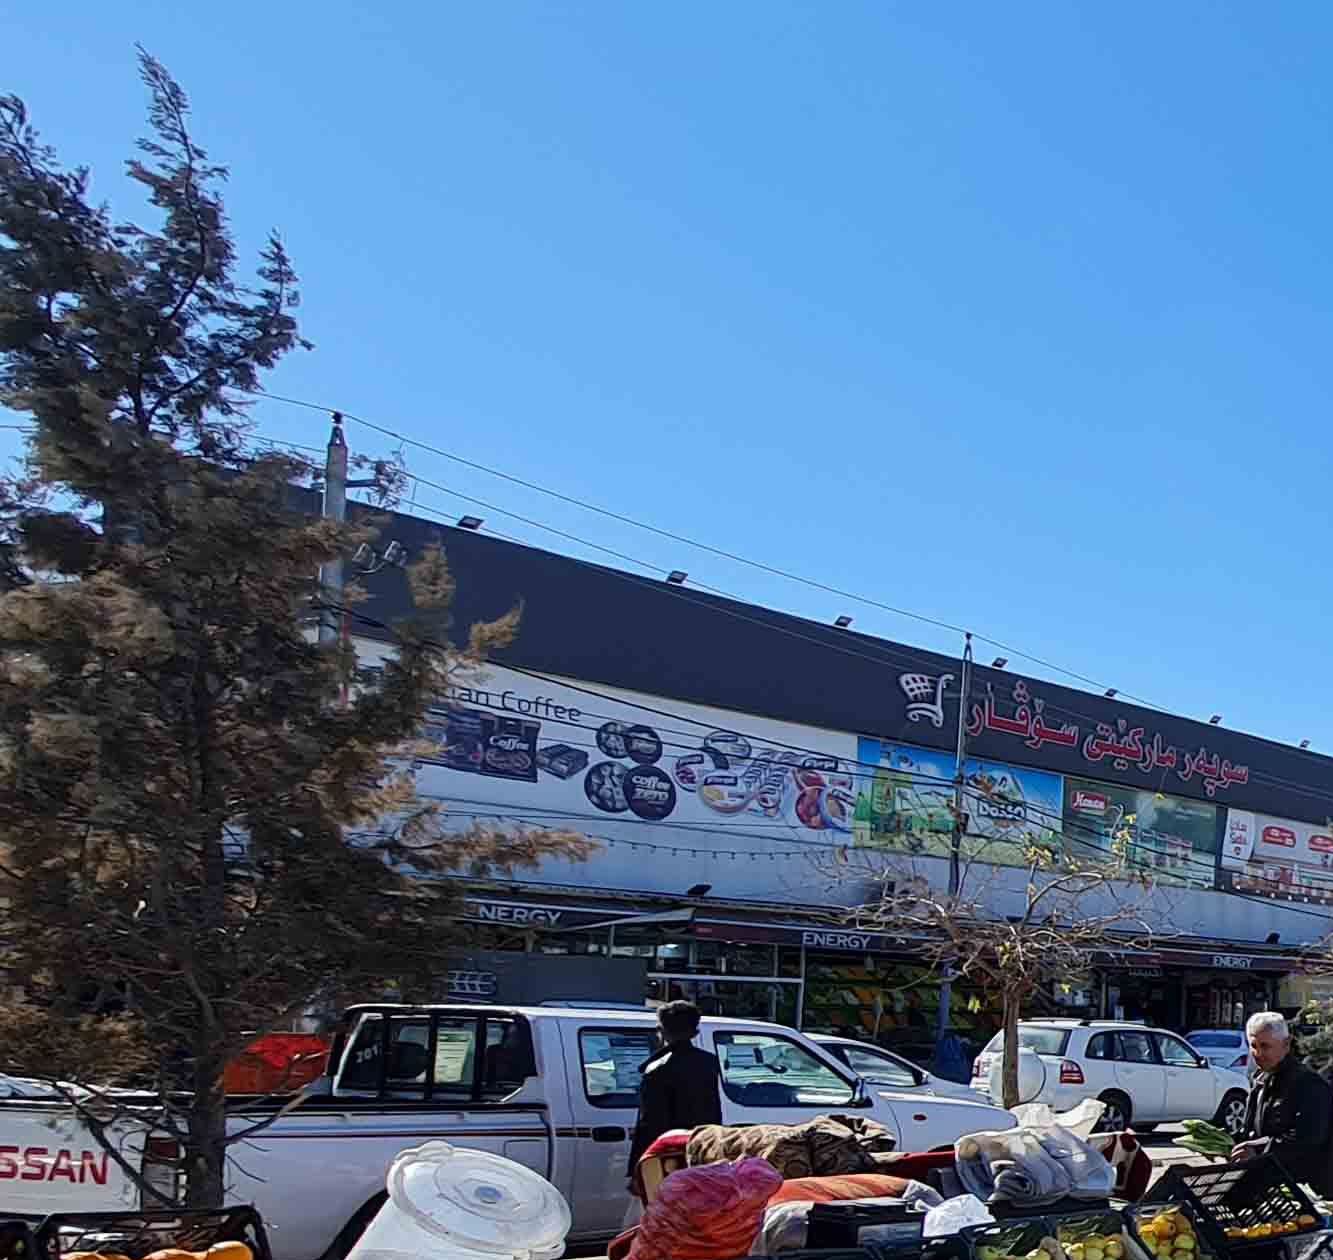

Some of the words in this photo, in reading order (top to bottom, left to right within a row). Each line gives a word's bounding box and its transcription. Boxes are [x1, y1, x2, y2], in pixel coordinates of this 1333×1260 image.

[500, 690, 582, 723] Coffee
[470, 903, 562, 926] NERGY
[802, 930, 872, 950] ENERGY
